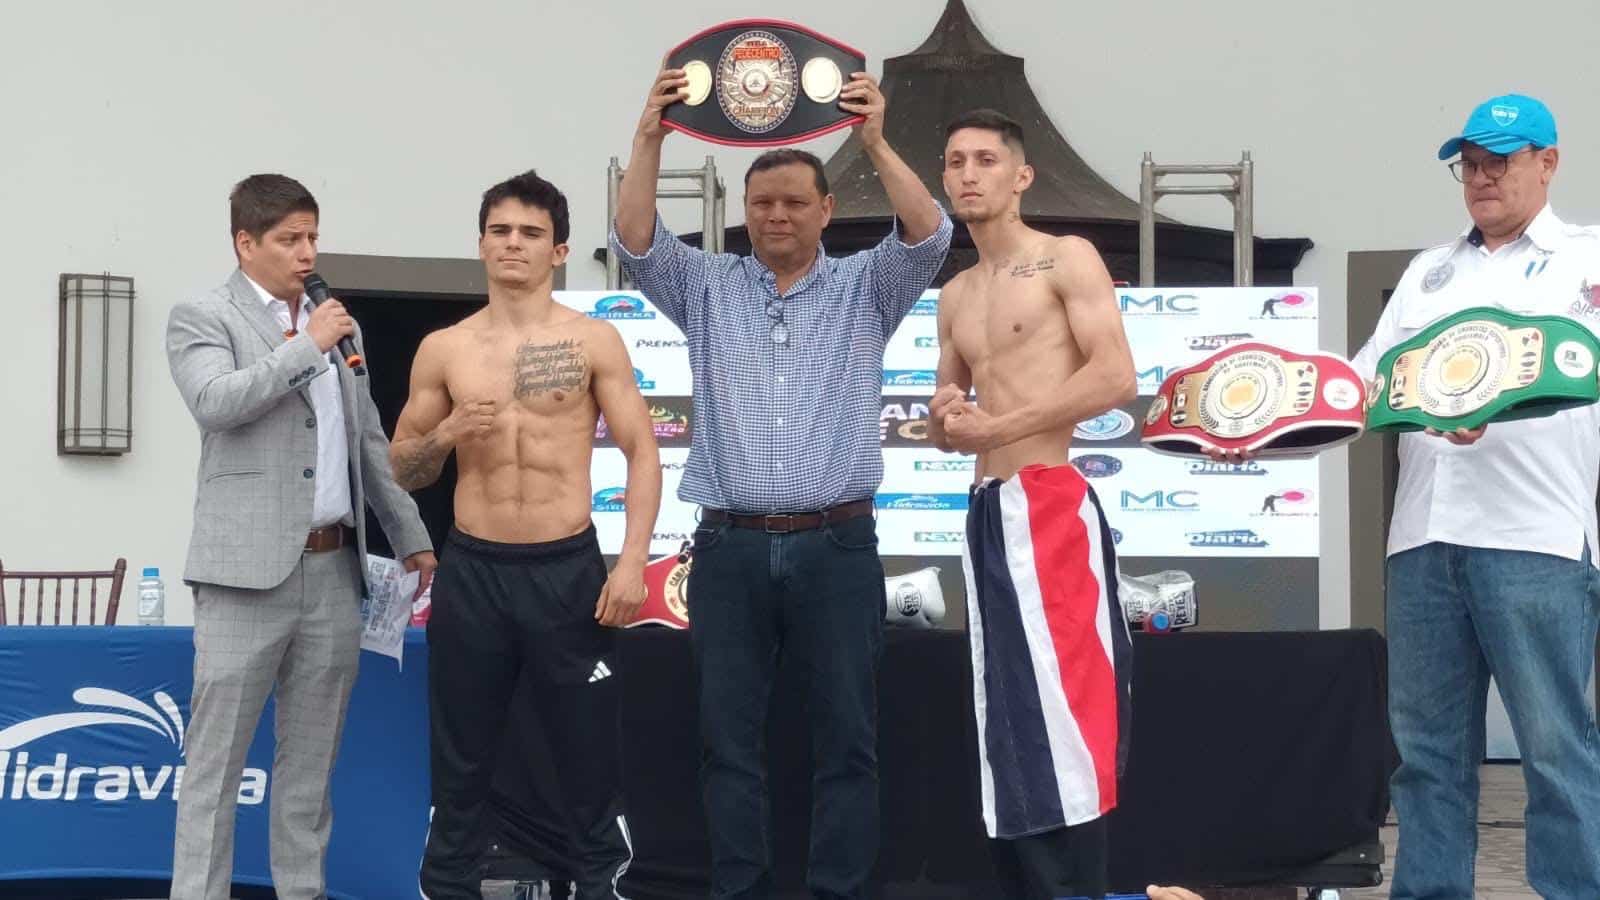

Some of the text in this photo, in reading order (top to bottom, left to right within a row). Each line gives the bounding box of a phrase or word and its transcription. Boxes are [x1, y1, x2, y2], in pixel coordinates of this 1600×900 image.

[1120, 295, 1199, 312] MC
[1120, 490, 1199, 507] MC
[0, 750, 268, 805] idravia
